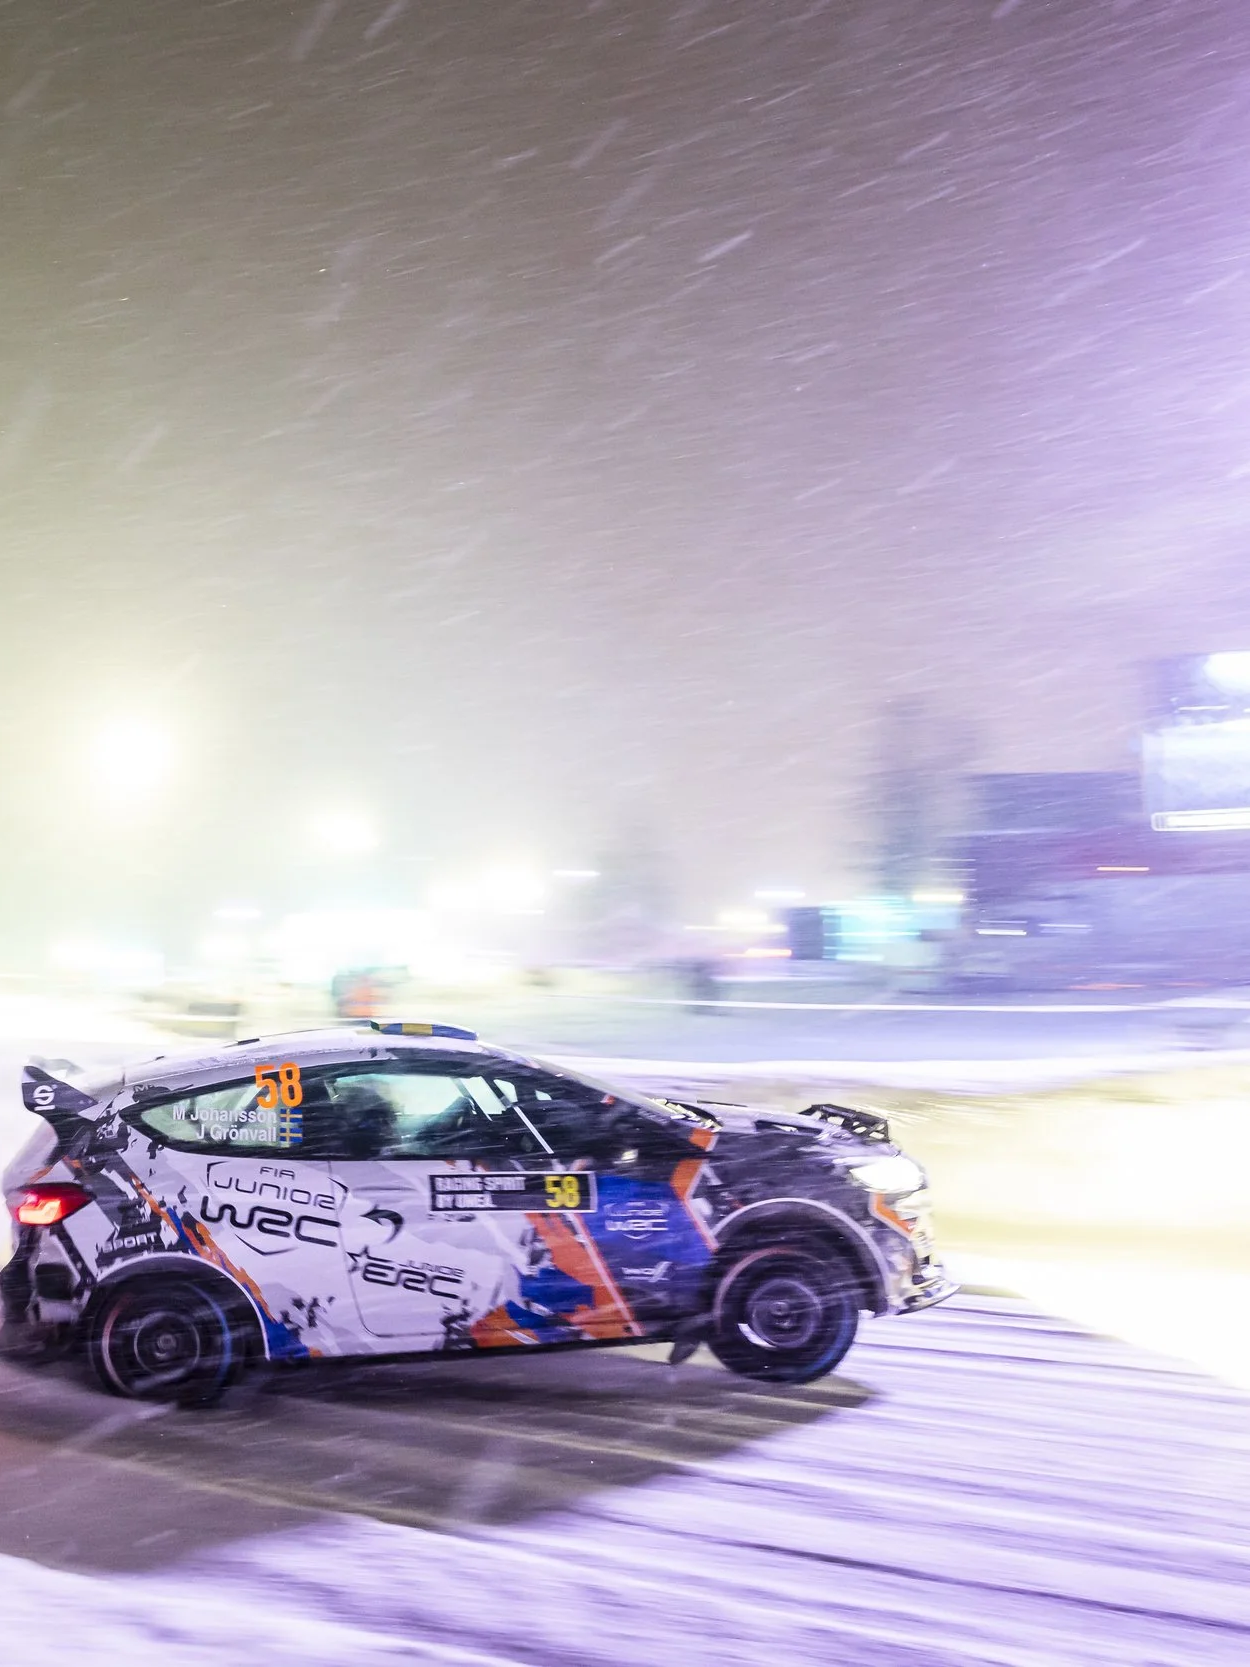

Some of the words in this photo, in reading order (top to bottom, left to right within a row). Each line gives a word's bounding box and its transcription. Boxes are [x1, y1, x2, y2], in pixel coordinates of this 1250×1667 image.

[255, 1062, 303, 1109] 58
[173, 1105, 186, 1121] M
[190, 1106, 277, 1124] Johansson
[196, 1124, 205, 1140] J
[210, 1123, 277, 1142] Grönvall
[259, 1166, 296, 1180] FIA
[214, 1177, 336, 1210] JUNIOR
[544, 1175, 581, 1208] 58
[200, 1195, 342, 1248] WRC
[605, 1219, 669, 1231] WRC
